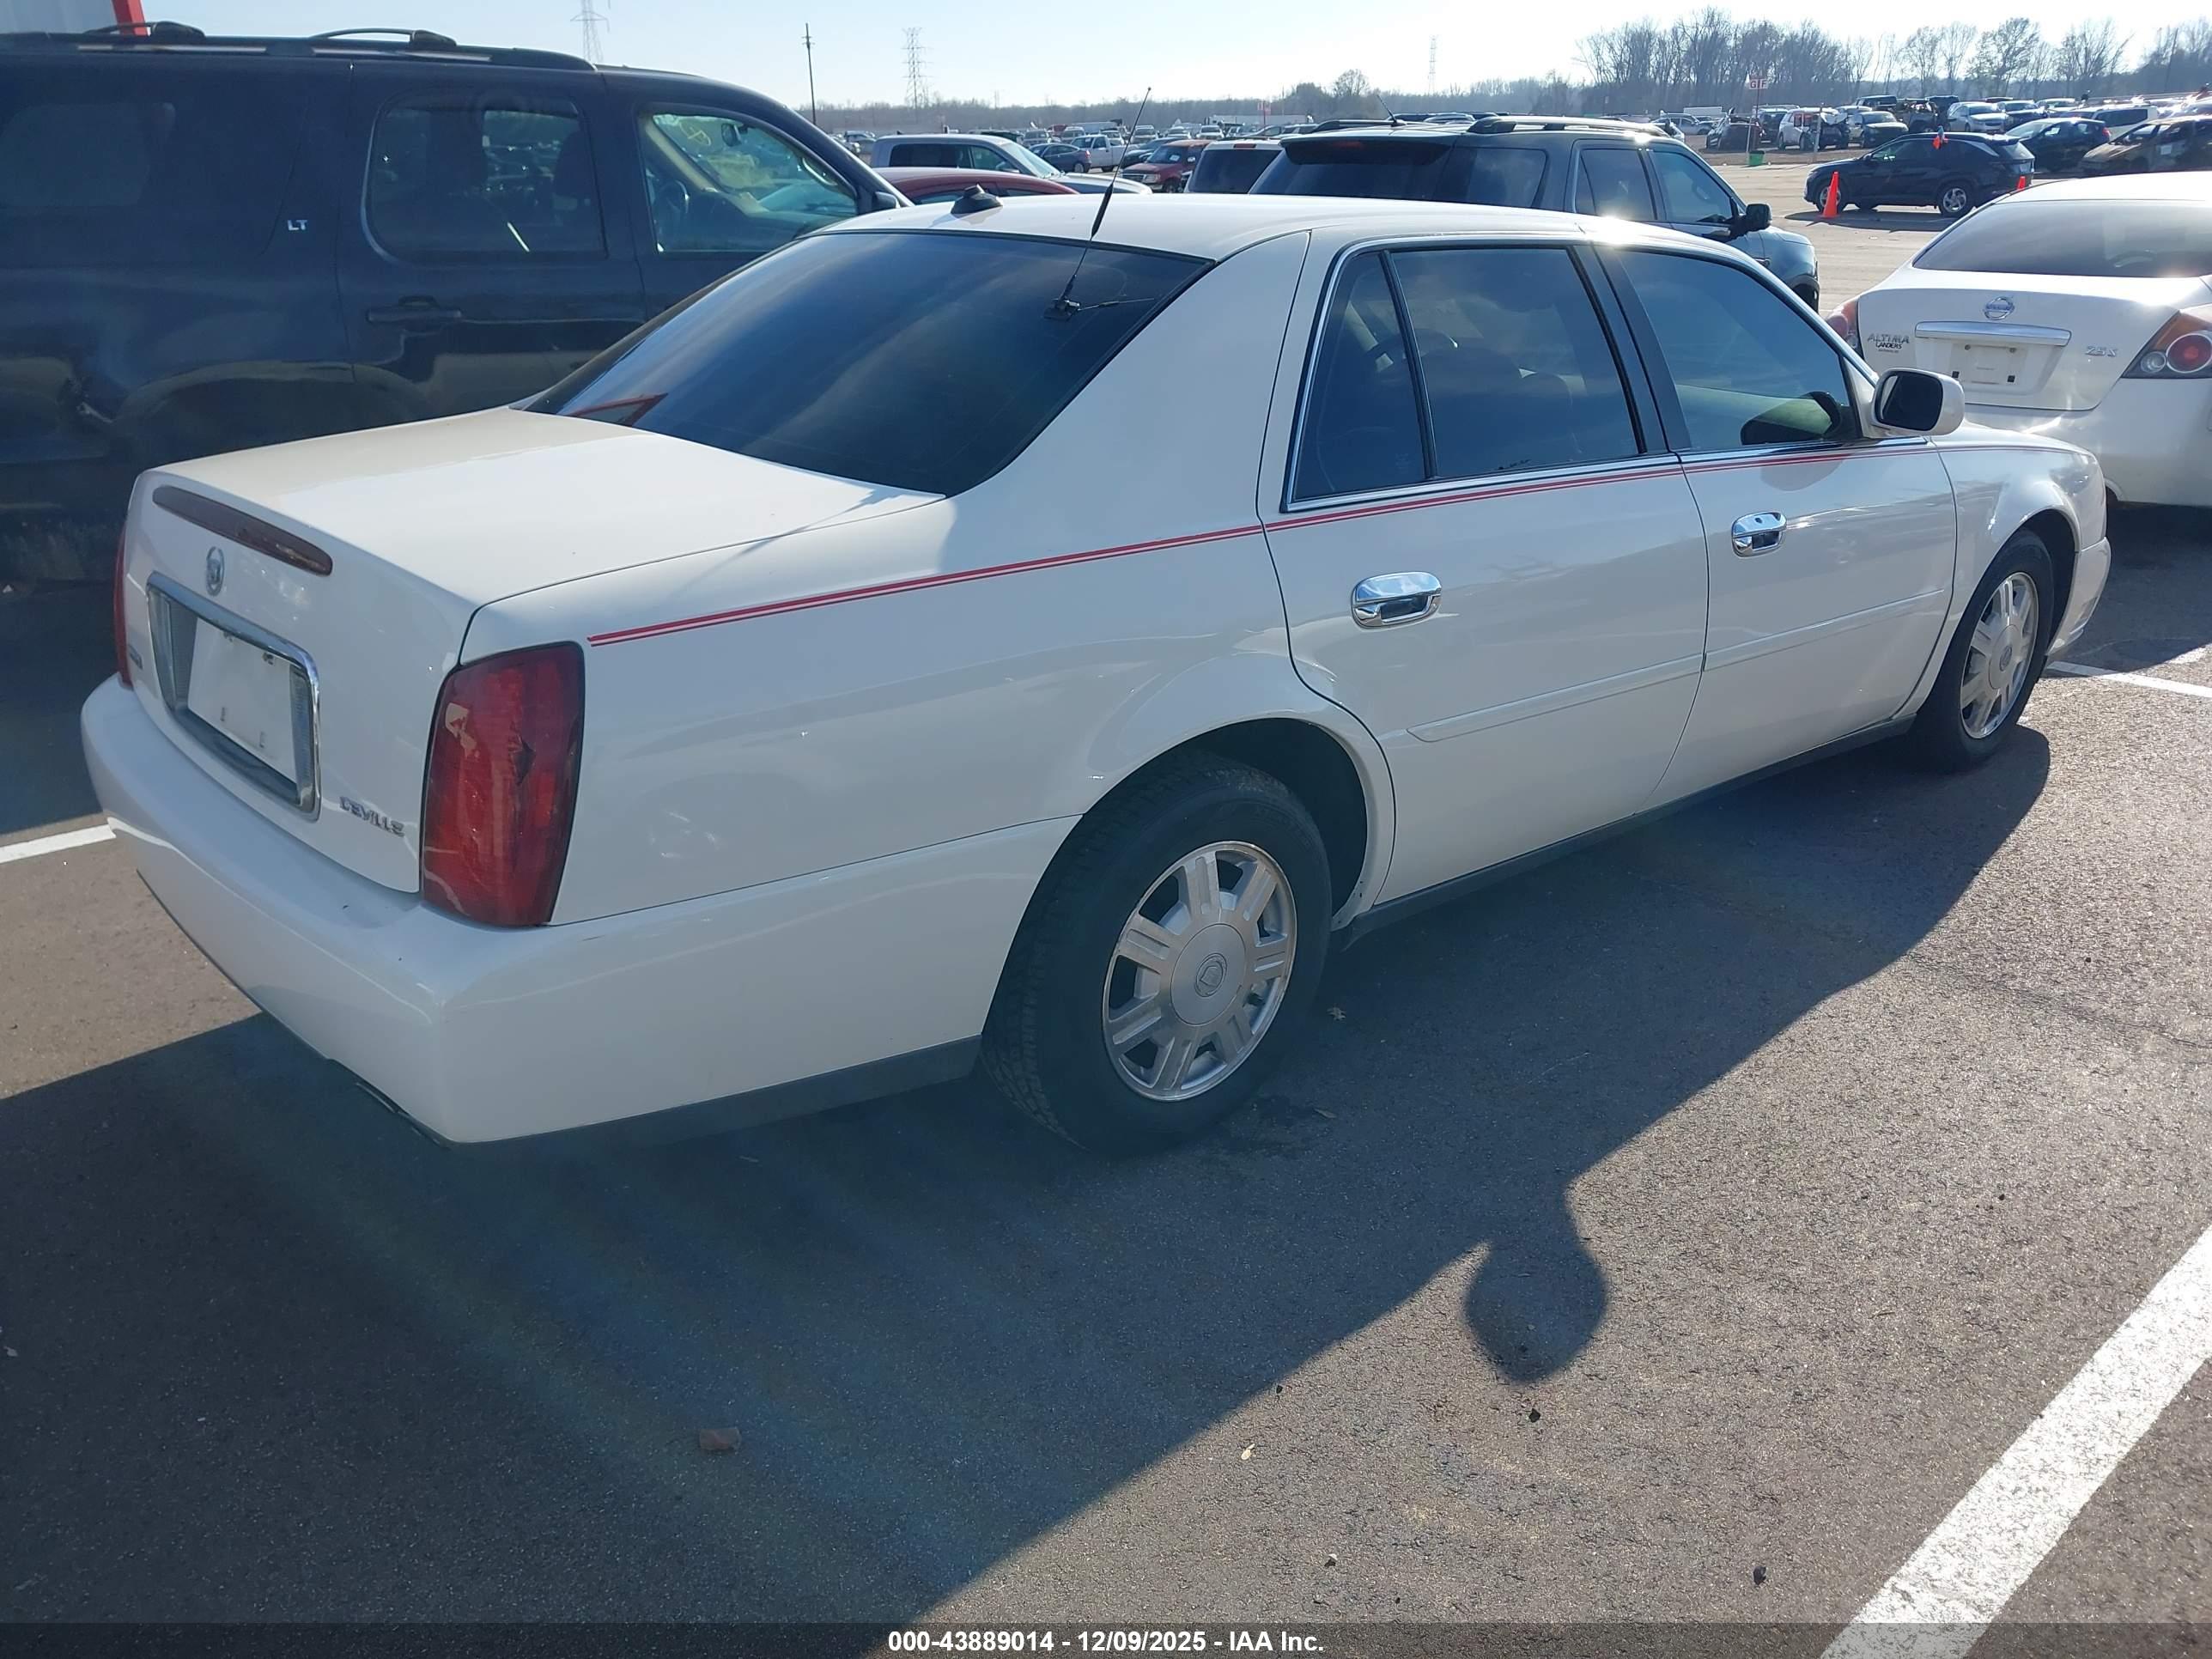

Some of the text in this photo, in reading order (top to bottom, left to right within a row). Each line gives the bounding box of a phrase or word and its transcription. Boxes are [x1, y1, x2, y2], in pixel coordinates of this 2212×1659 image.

[287, 219, 308, 231] LT
[1867, 333, 1910, 343] ALTIMA
[339, 796, 405, 837] DEVILLE
